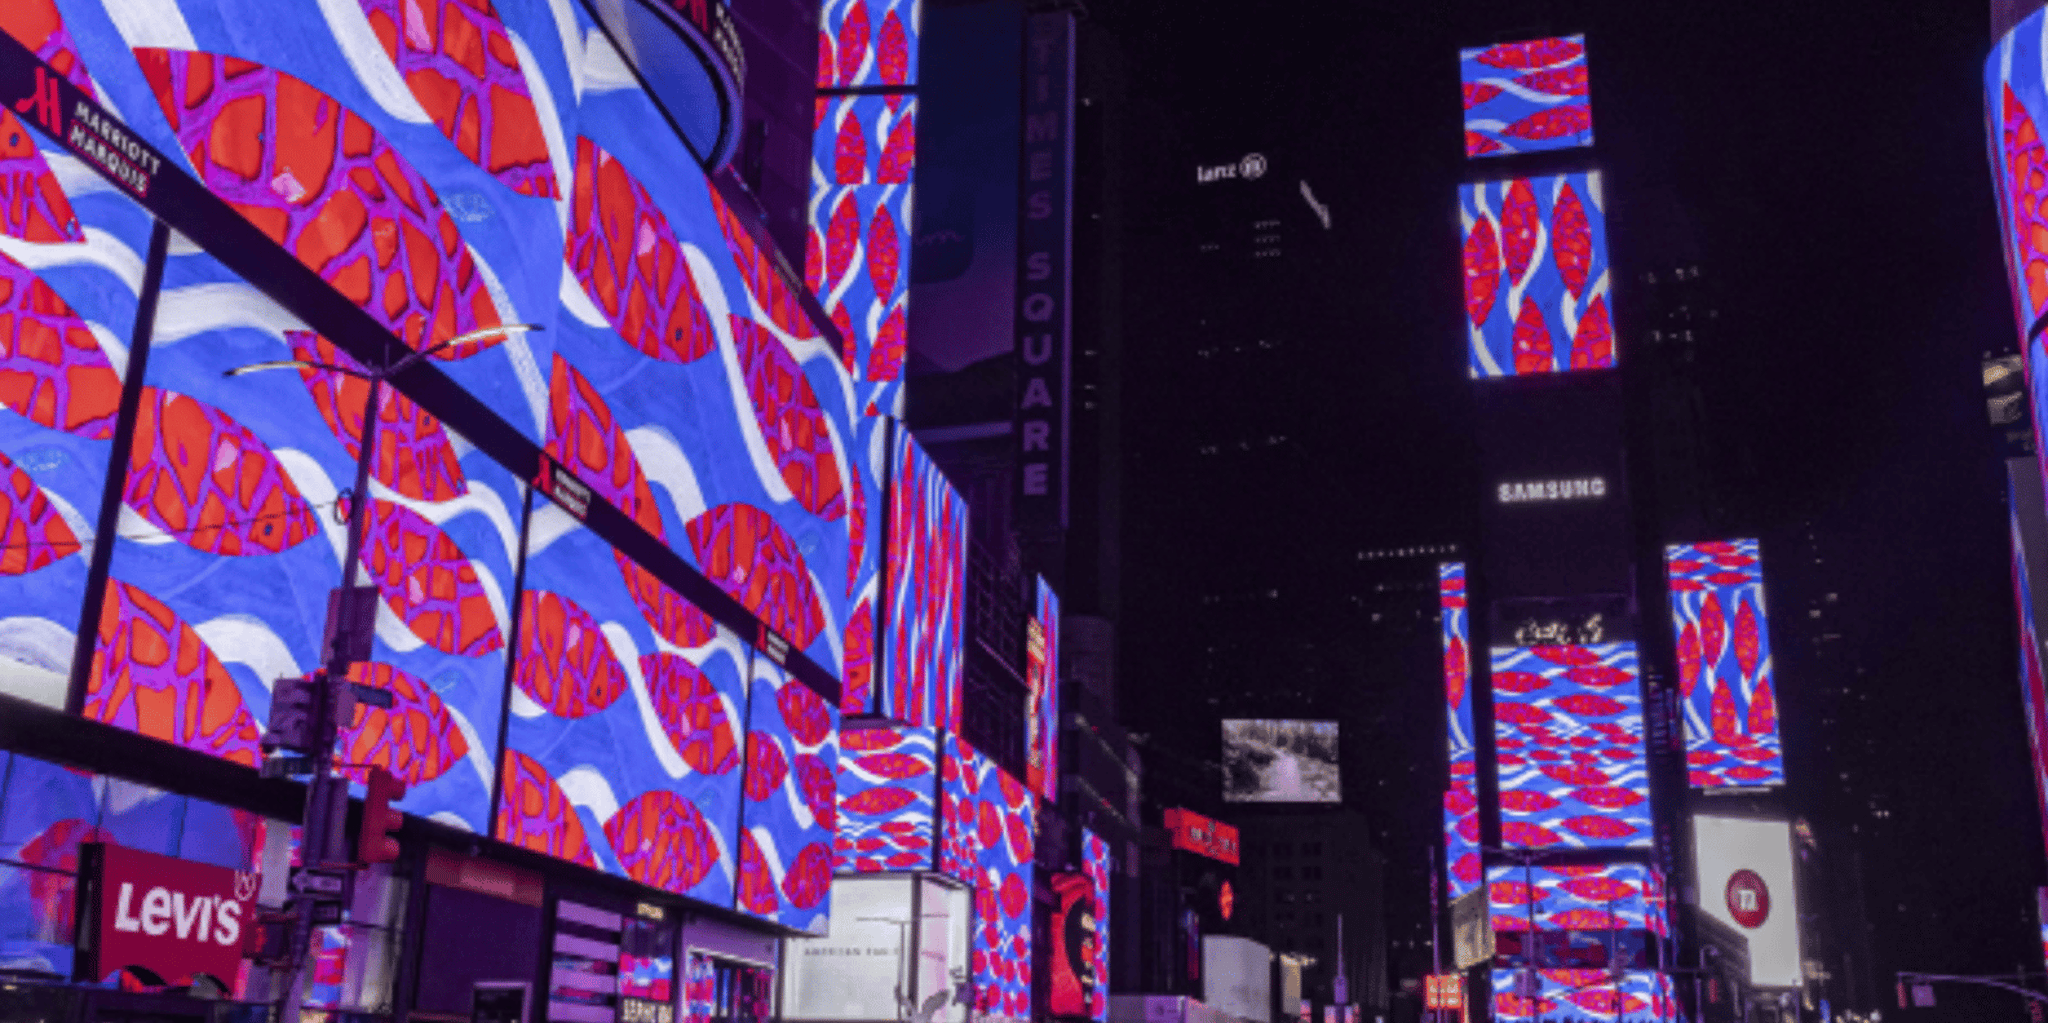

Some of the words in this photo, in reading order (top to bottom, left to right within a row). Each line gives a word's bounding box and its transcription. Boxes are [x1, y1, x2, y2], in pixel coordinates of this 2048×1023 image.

[70, 124, 148, 193] MARQUIS
[74, 101, 161, 176] MARRIOTT
[1026, 37, 1059, 220] TIMES
[1021, 251, 1055, 495] SQUARE
[1498, 478, 1606, 502] SAMSUNG
